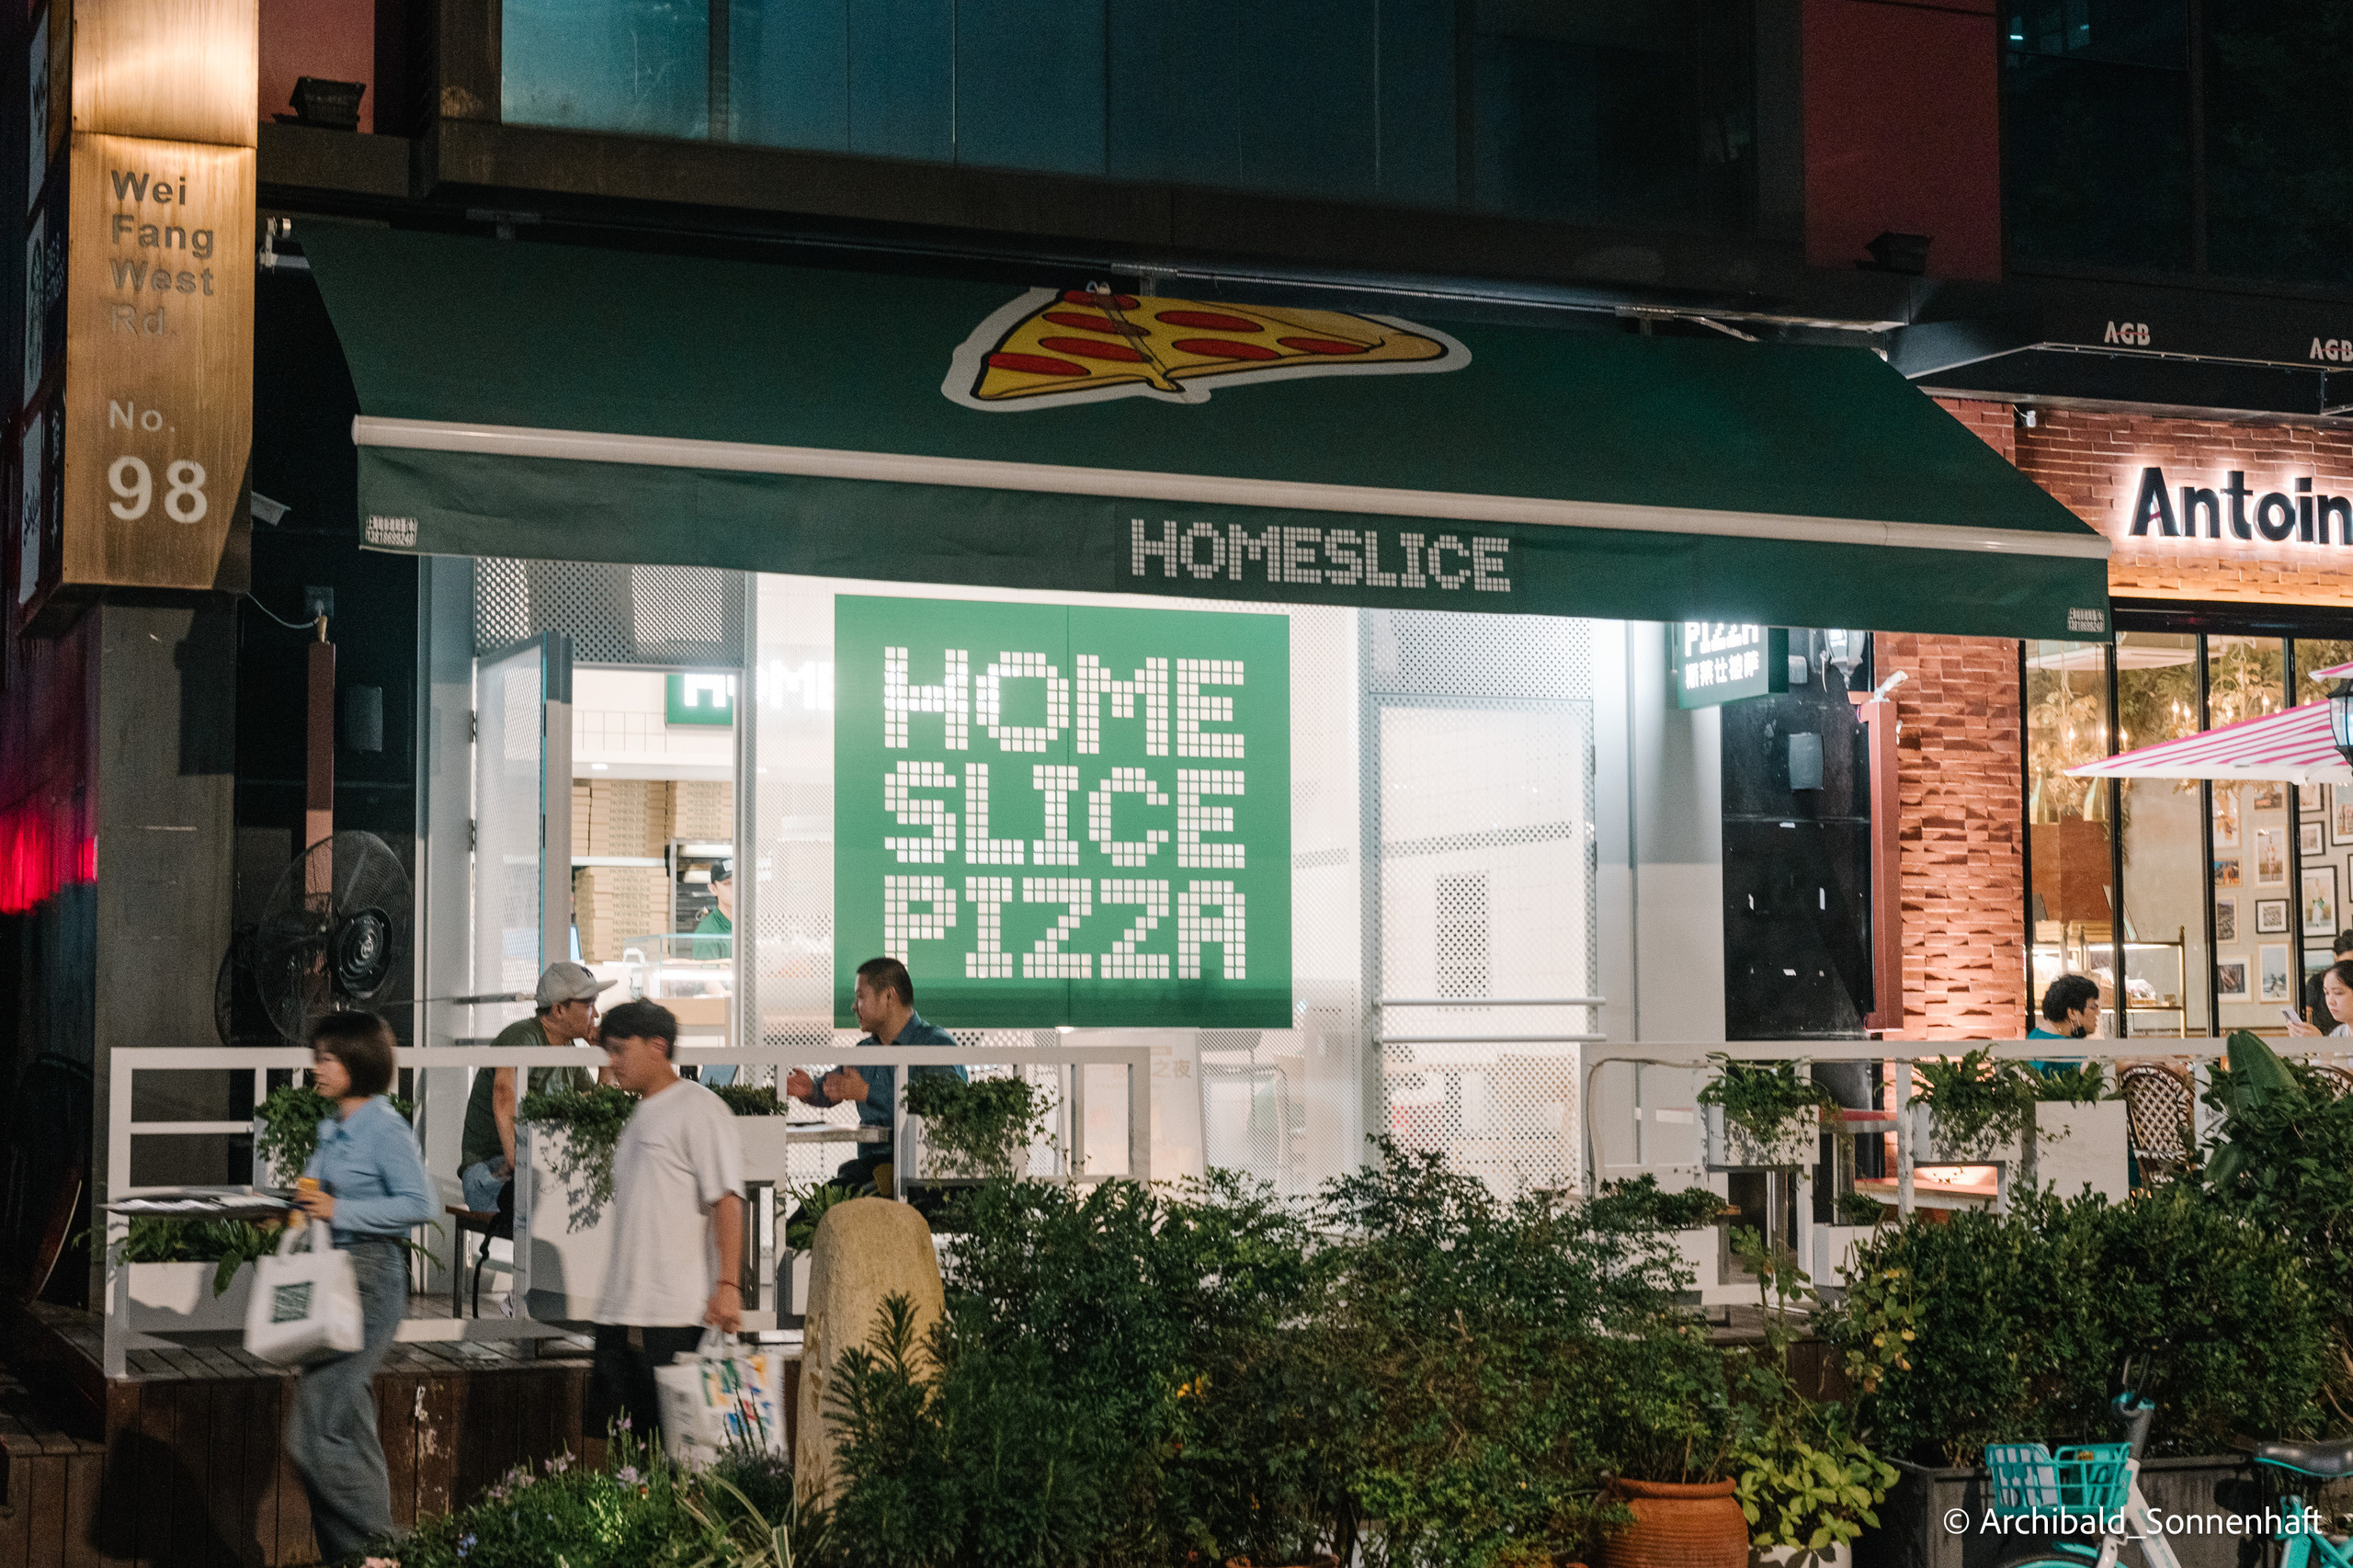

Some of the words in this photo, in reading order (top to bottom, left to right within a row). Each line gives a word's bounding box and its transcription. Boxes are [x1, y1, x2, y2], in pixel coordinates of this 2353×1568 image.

[111, 170, 187, 205] Wei
[112, 213, 213, 259] Fang
[110, 258, 213, 296] West
[2104, 321, 2151, 346] AGB
[2310, 336, 2353, 362] AGB
[109, 400, 176, 432] No.
[108, 455, 208, 524] 98
[2129, 467, 2353, 546] Antoin
[1131, 518, 1511, 592] HOMESLICE
[884, 646, 1245, 759] HOME
[884, 760, 1245, 869] SLICE
[884, 874, 1246, 980] PIZZA
